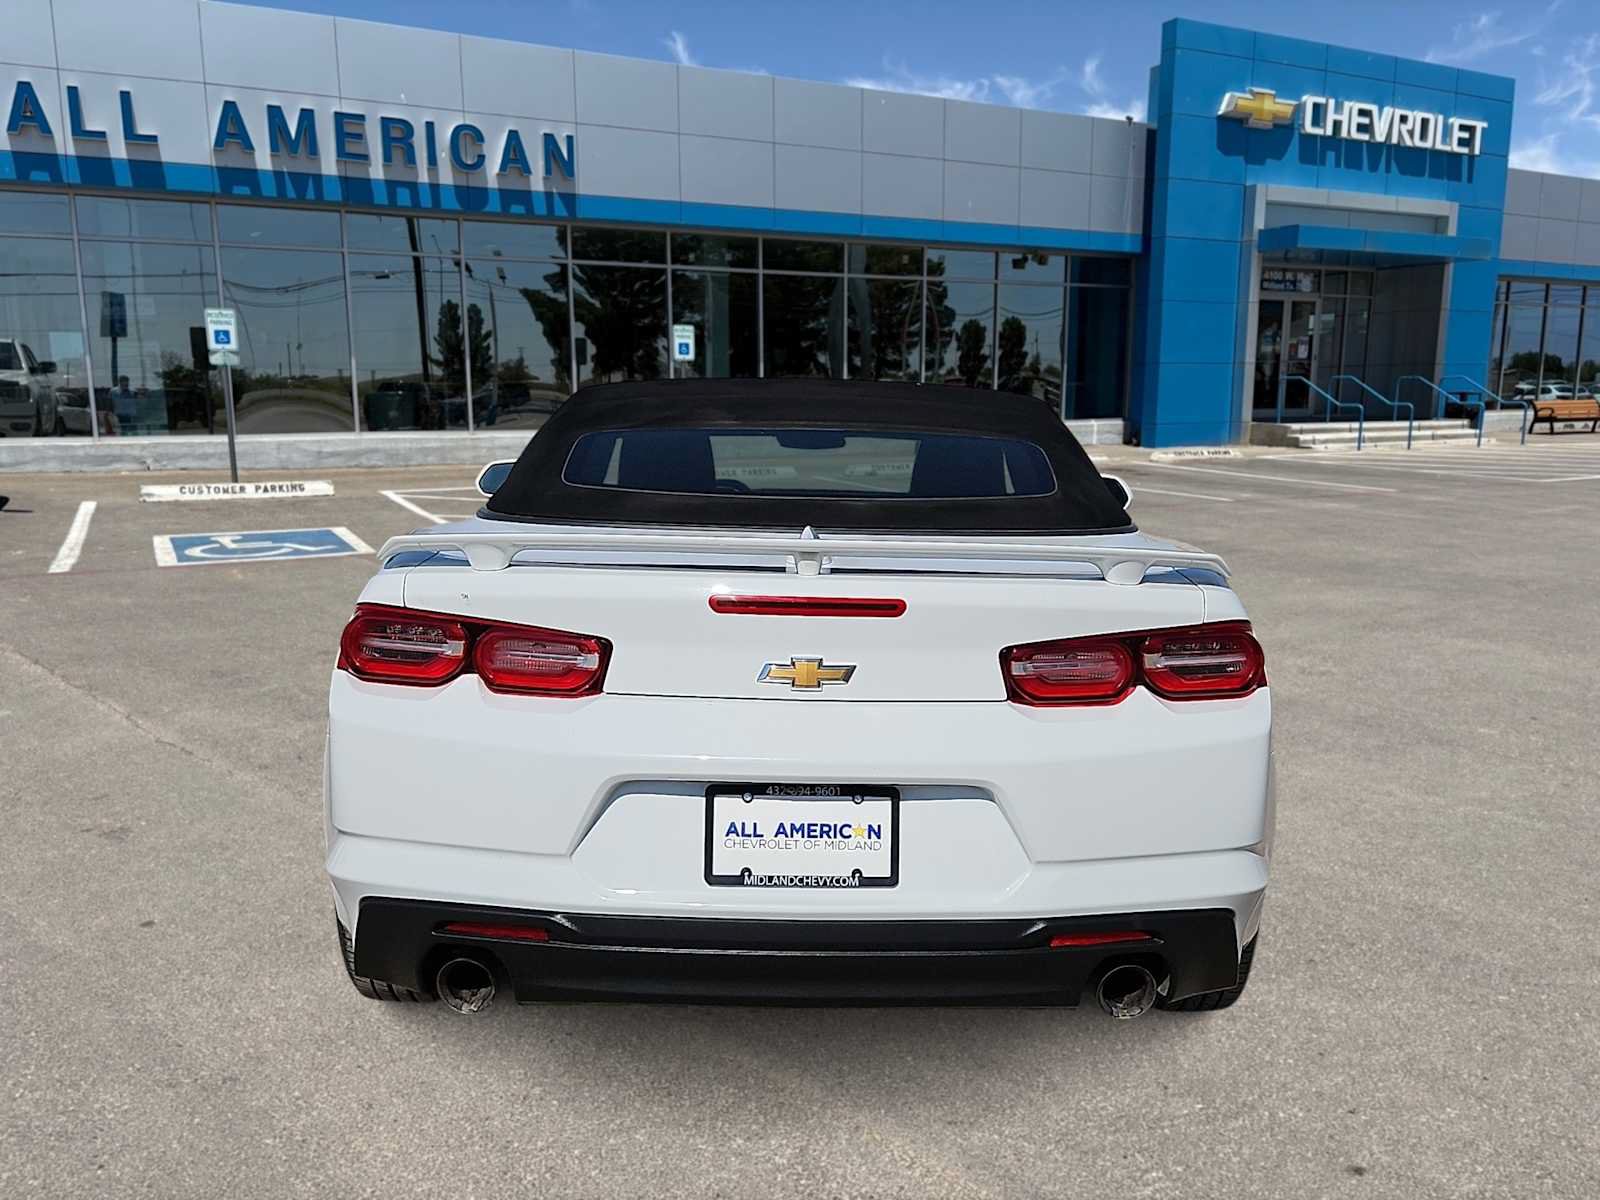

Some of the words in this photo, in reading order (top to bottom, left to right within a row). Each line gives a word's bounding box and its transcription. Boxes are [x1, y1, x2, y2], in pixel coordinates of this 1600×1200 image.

[6, 80, 159, 144] ALL
[213, 99, 576, 180] AMERICAN
[1301, 94, 1488, 156] CHEVROLET
[179, 486, 246, 496] CUSTOMER
[254, 483, 306, 494] PARKING
[725, 822, 764, 838] ALL
[774, 822, 881, 839] AMERICN
[724, 838, 799, 850] CHEVROLET
[803, 840, 821, 850] OF
[824, 840, 882, 851] MIDLAND
[743, 875, 860, 886] MIDLANDCHEVY.COM
